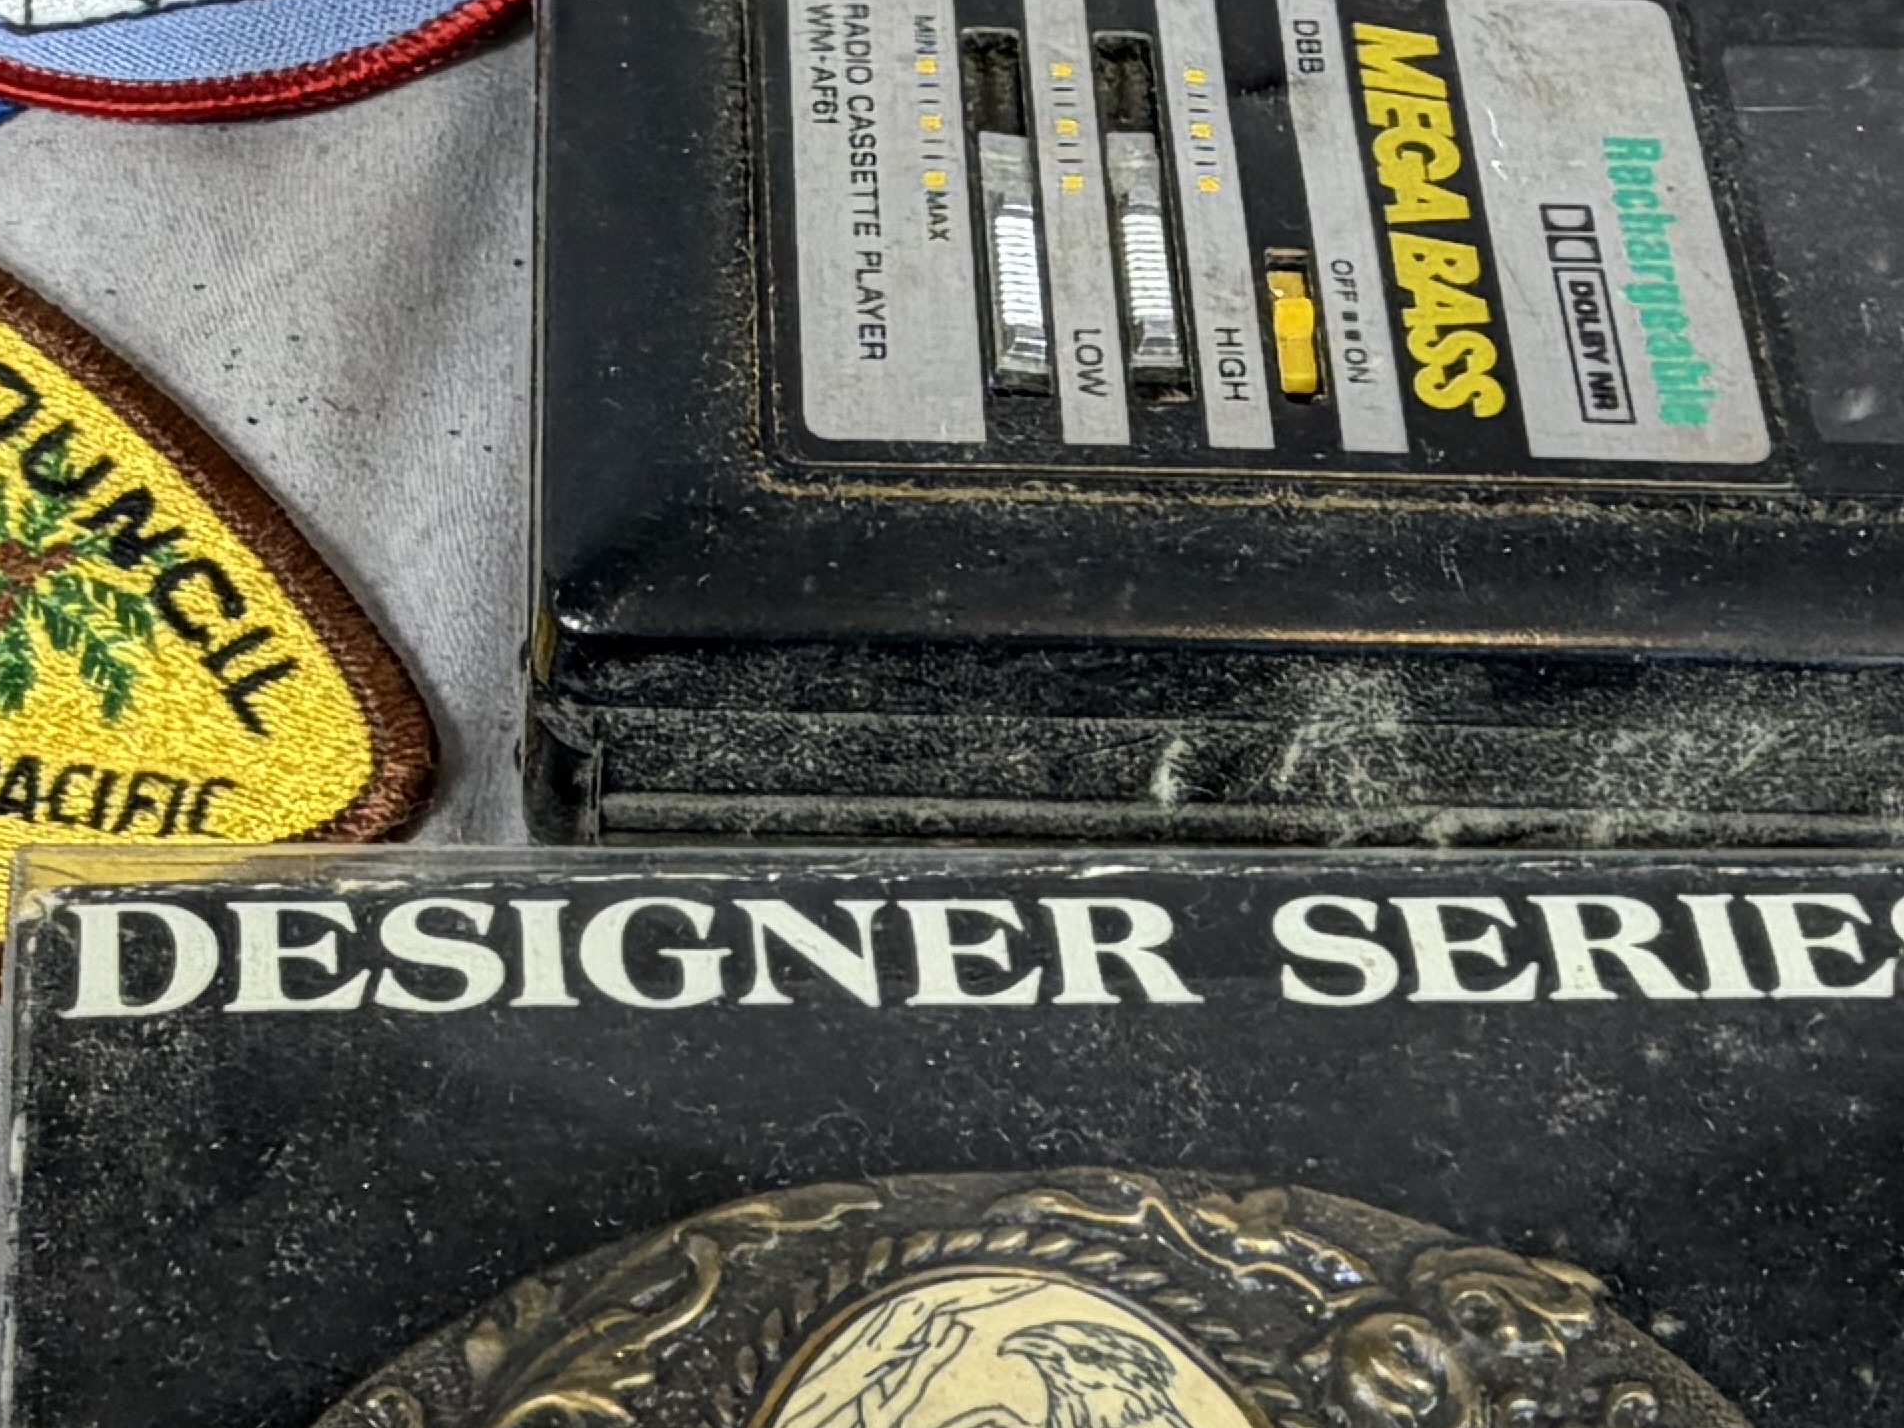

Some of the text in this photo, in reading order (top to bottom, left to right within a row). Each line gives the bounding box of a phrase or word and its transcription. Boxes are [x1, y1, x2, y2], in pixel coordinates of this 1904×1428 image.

[803, 4, 842, 125] WM-AF61
[1291, 19, 1326, 77] DBB
[839, 3, 891, 363] RADIO CASSETTE PLAYER
[924, 190, 950, 243] MAX
[1352, 21, 1506, 422] MEGA BASS
[1329, 257, 1375, 388] OFF ON
[1568, 277, 1610, 367] DOLBY
[1602, 133, 1720, 431] Rechargeable
[1072, 328, 1109, 399] LOW
[1213, 326, 1252, 404] HIGH
[58, 894, 1206, 1022] DESIGNER
